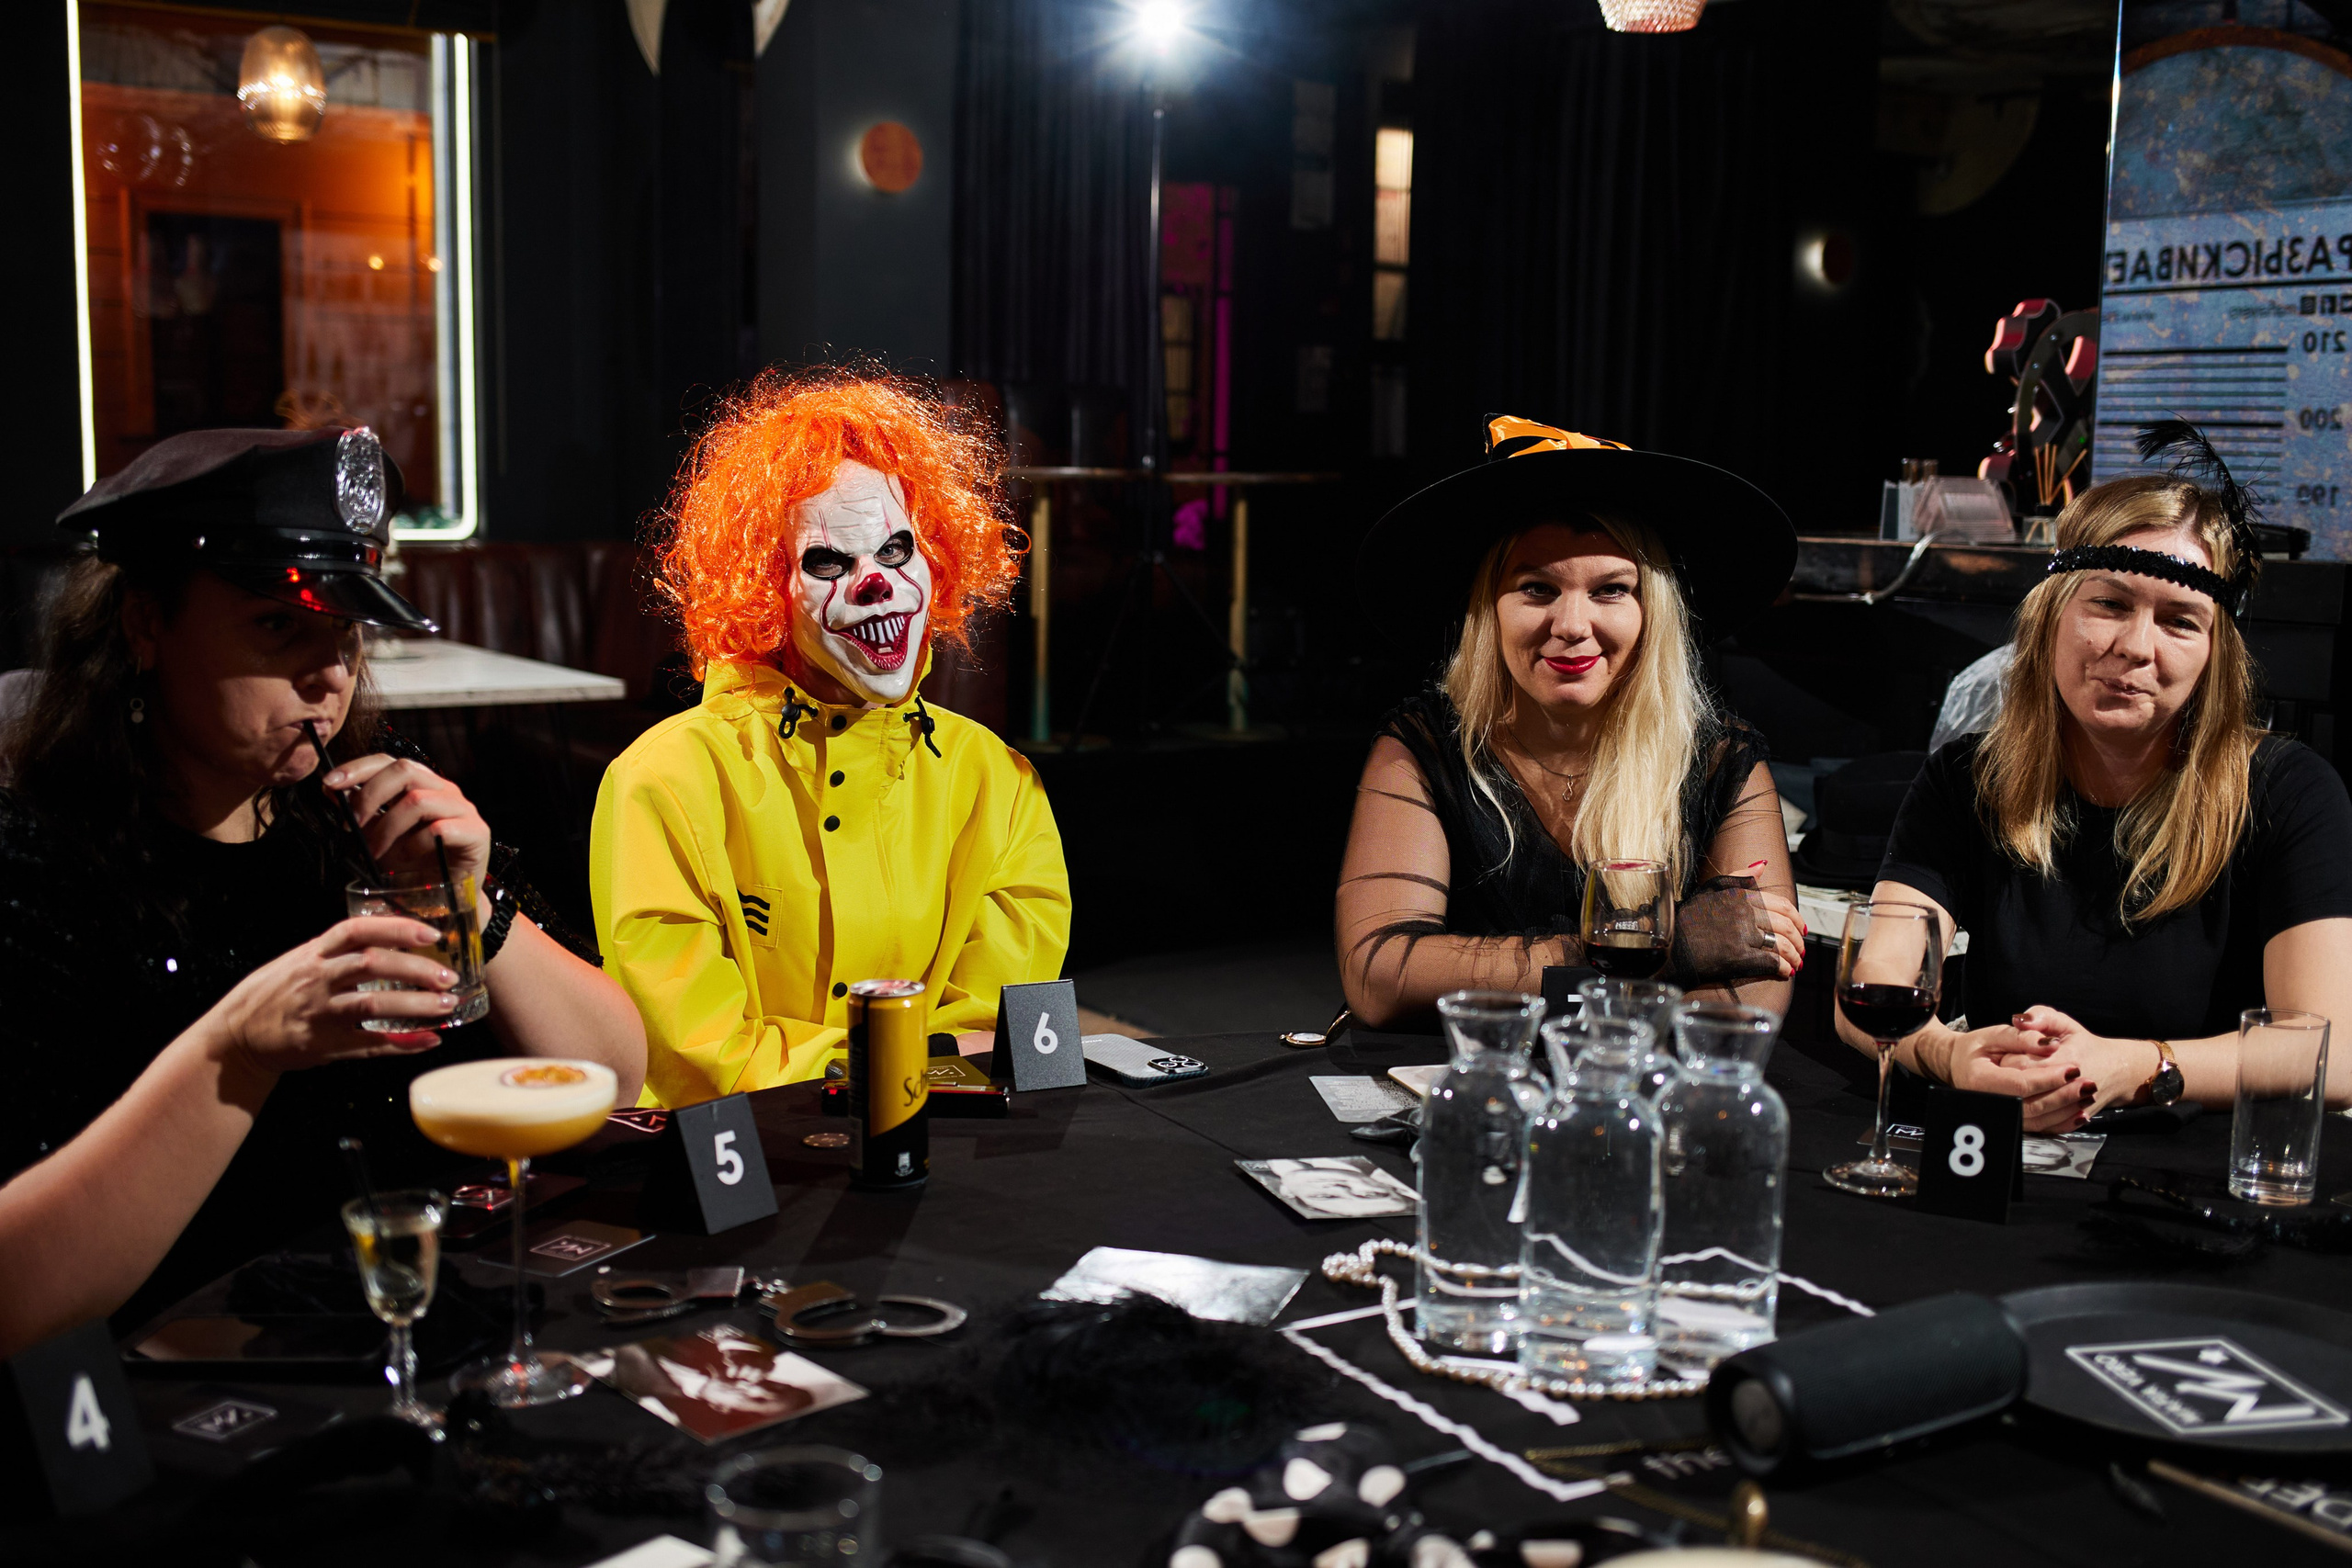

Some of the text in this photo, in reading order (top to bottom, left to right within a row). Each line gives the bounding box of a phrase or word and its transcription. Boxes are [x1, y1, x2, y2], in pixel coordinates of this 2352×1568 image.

[1034, 1011, 1058, 1055] 6
[714, 1130, 745, 1185] 5
[1948, 1123, 1985, 1177] 8
[67, 1374, 110, 1450] 4
